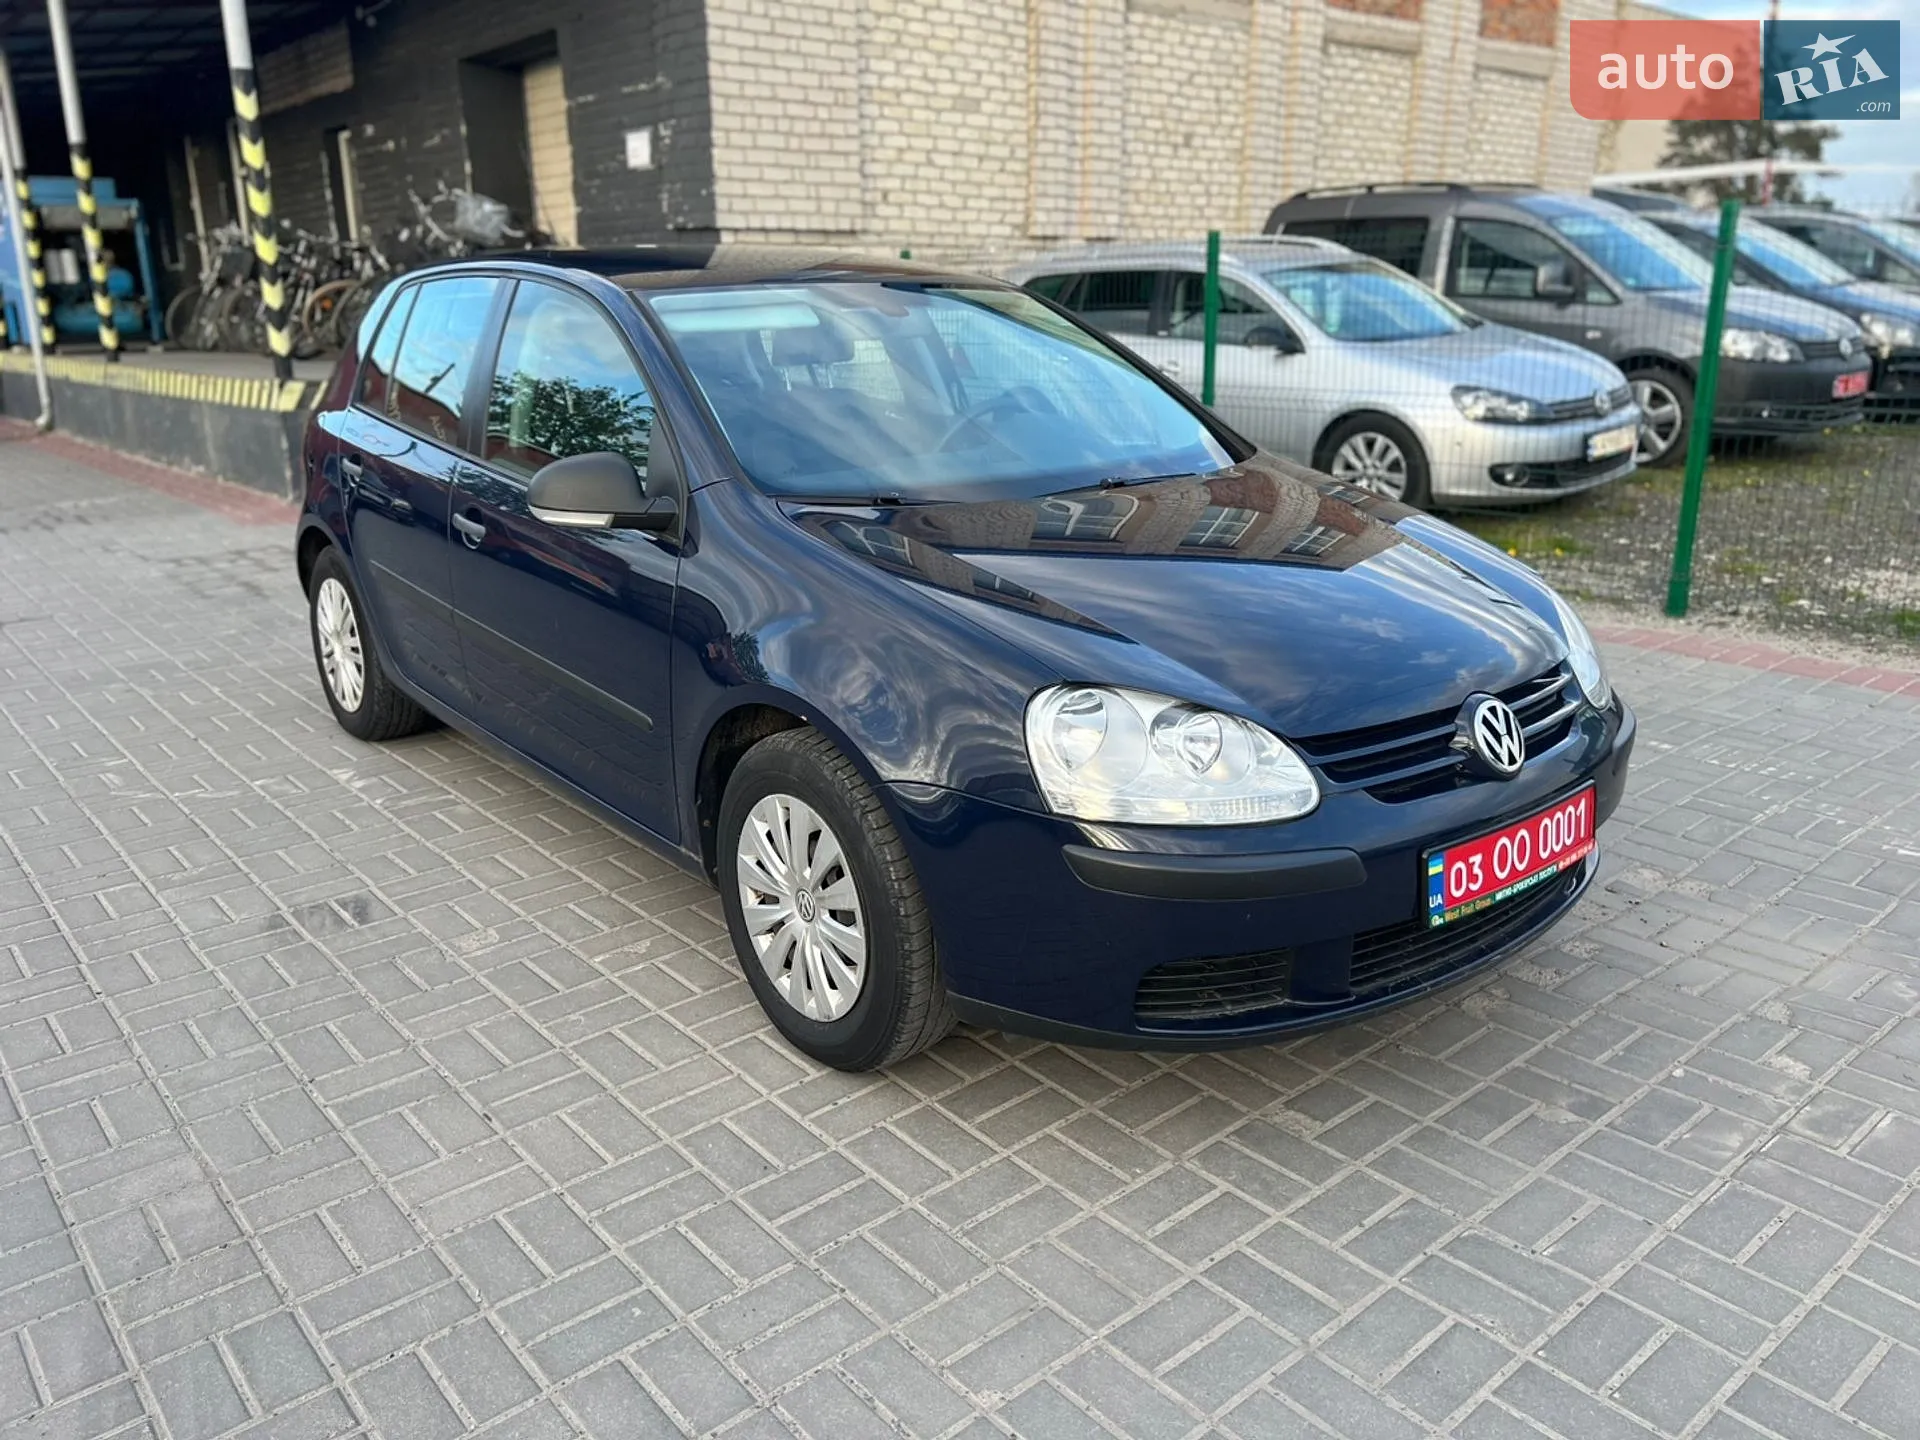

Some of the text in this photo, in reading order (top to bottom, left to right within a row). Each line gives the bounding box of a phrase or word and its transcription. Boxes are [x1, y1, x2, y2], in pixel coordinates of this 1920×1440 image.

[1450, 852, 1483, 898] 03
[1538, 798, 1587, 860] 0001
[1429, 894, 1443, 908] UA
